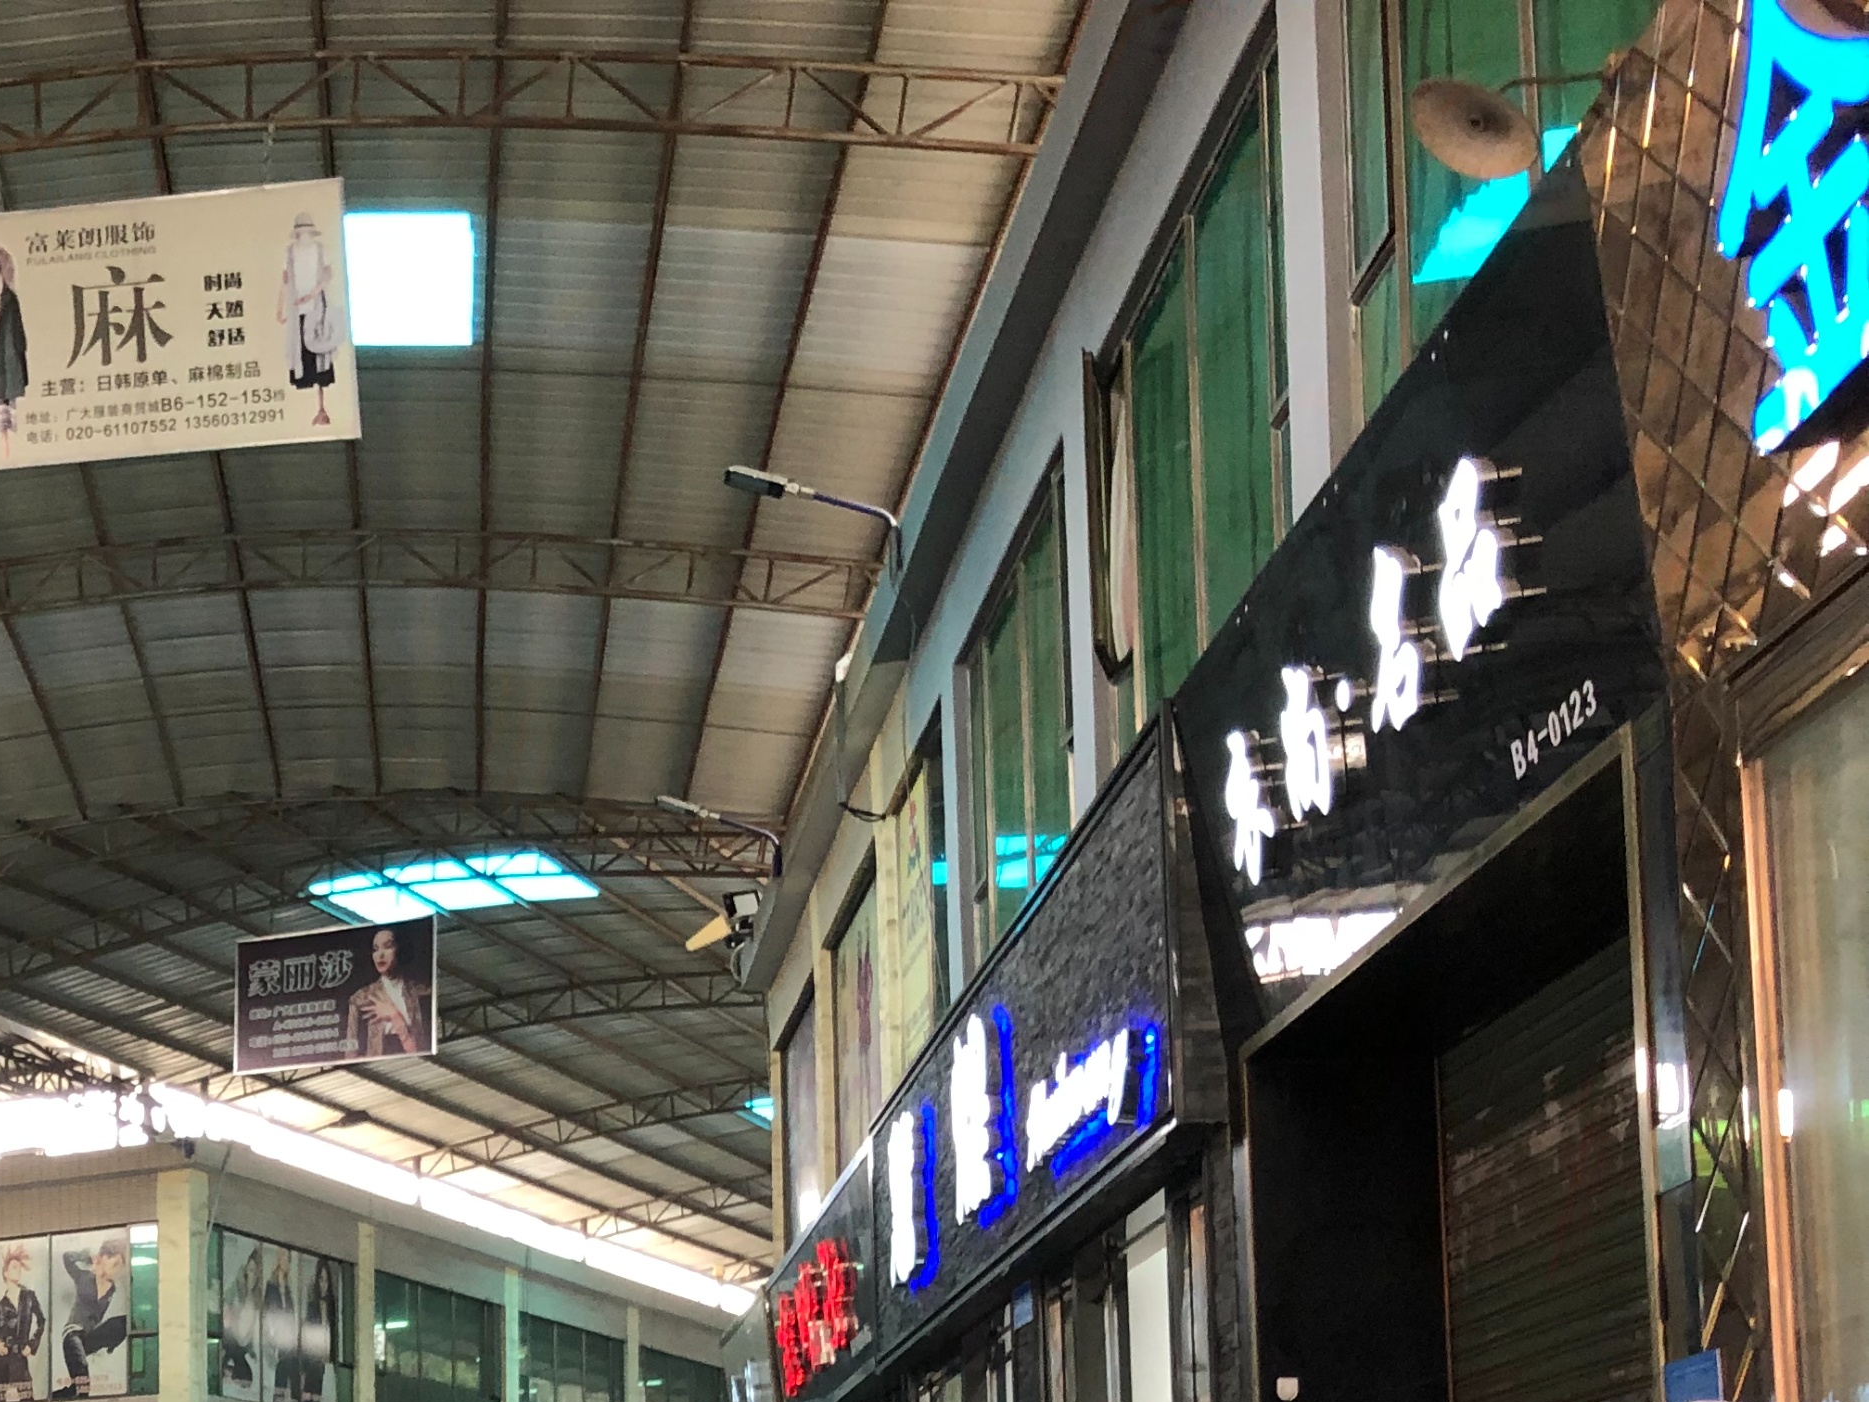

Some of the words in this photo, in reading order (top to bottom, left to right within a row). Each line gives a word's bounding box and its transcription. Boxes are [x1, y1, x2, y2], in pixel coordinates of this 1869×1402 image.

[25, 221, 155, 254] 富莱朗服饰
[204, 272, 242, 291] 时尚
[66, 265, 173, 368] 麻
[205, 300, 243, 320] 天然
[208, 327, 245, 347] 舒适
[185, 408, 285, 430] 13560312991
[1510, 680, 1598, 780] B4-0123
[248, 949, 353, 998] 蒙丽莎
